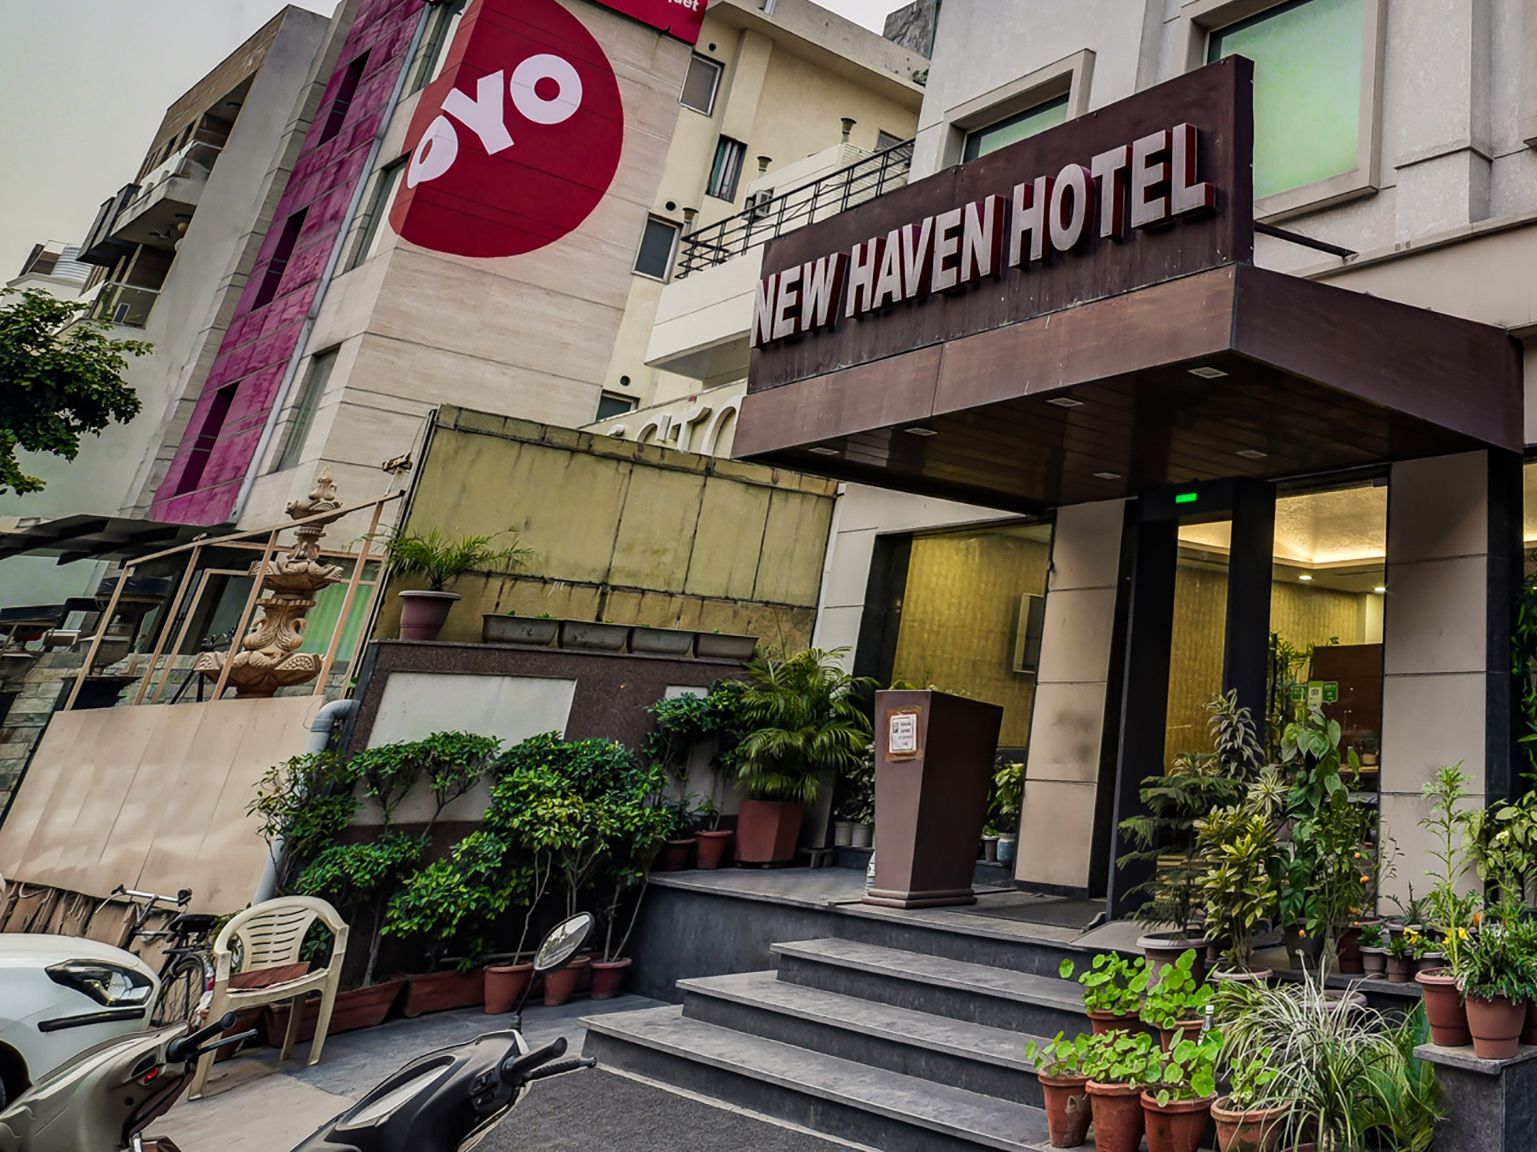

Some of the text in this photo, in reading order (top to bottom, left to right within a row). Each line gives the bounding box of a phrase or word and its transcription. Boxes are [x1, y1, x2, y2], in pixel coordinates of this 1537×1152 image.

[406, 53, 583, 189] OYO
[750, 122, 1216, 348] NEW HAVEN HOTEL
